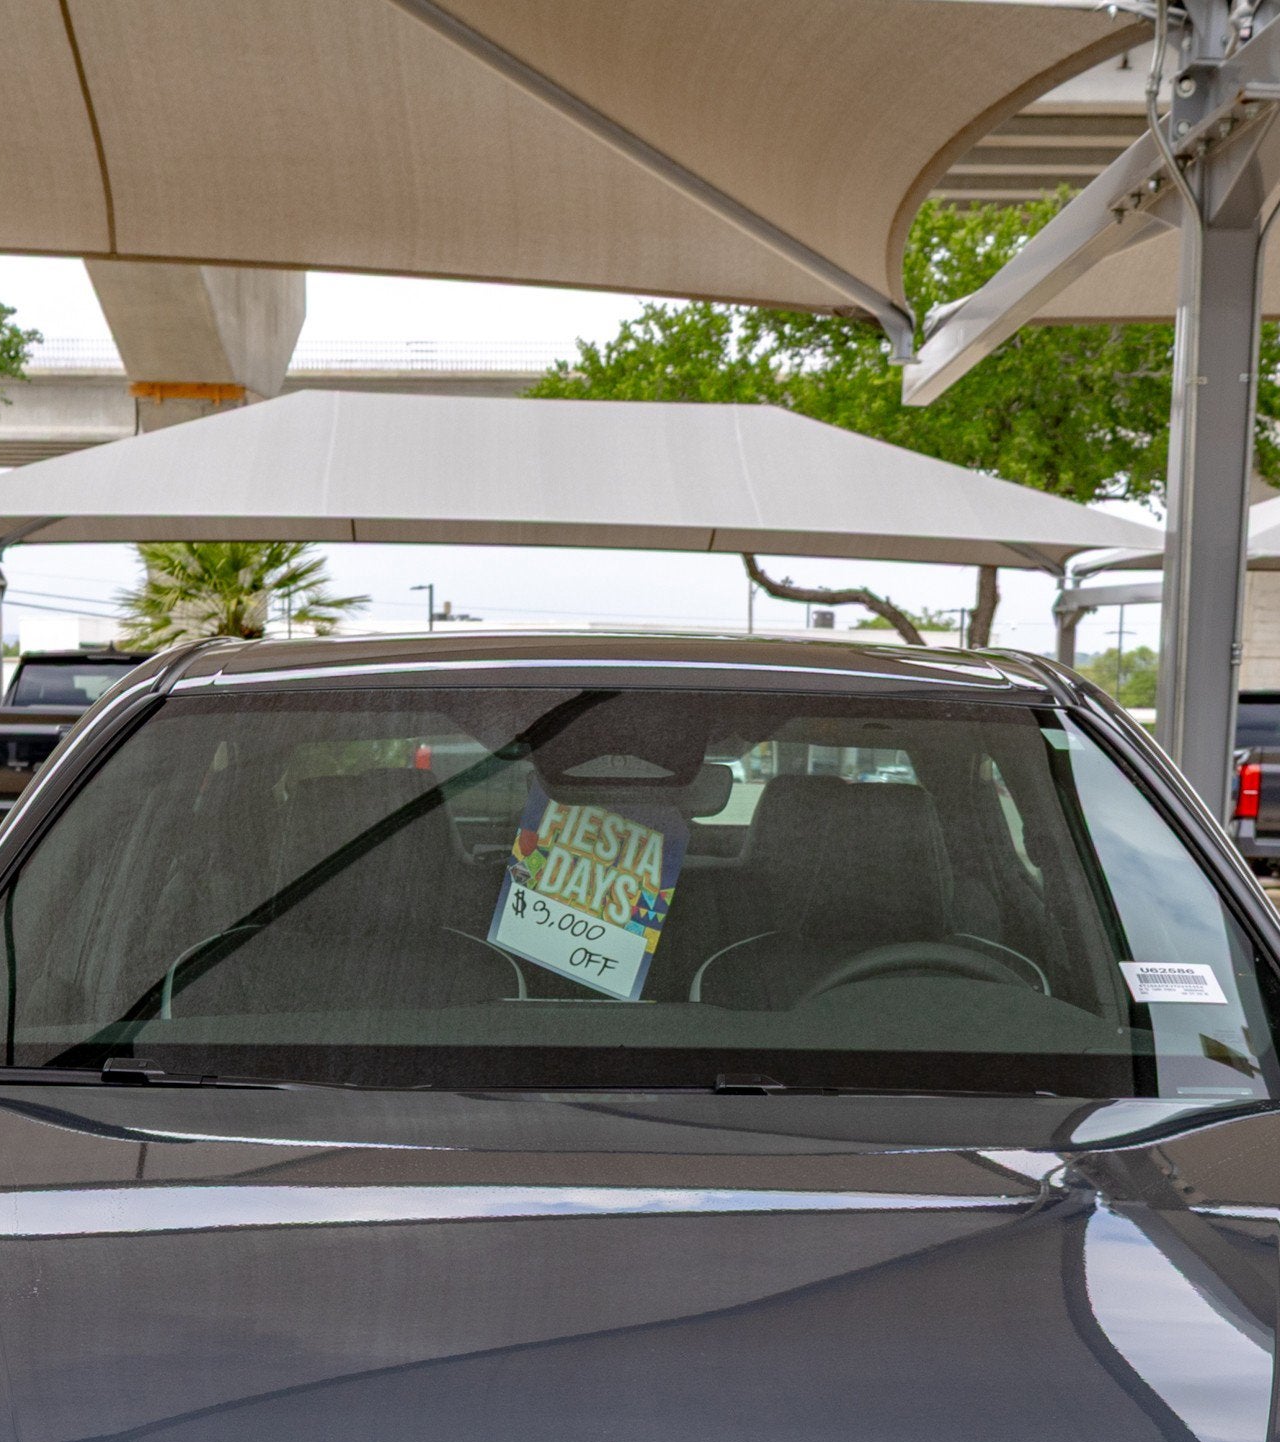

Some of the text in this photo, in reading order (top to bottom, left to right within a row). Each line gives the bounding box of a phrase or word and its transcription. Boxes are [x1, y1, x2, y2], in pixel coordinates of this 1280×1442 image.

[537, 800, 664, 891] FIESTA
[538, 847, 640, 926] DAYS
[569, 947, 620, 977] OFF
